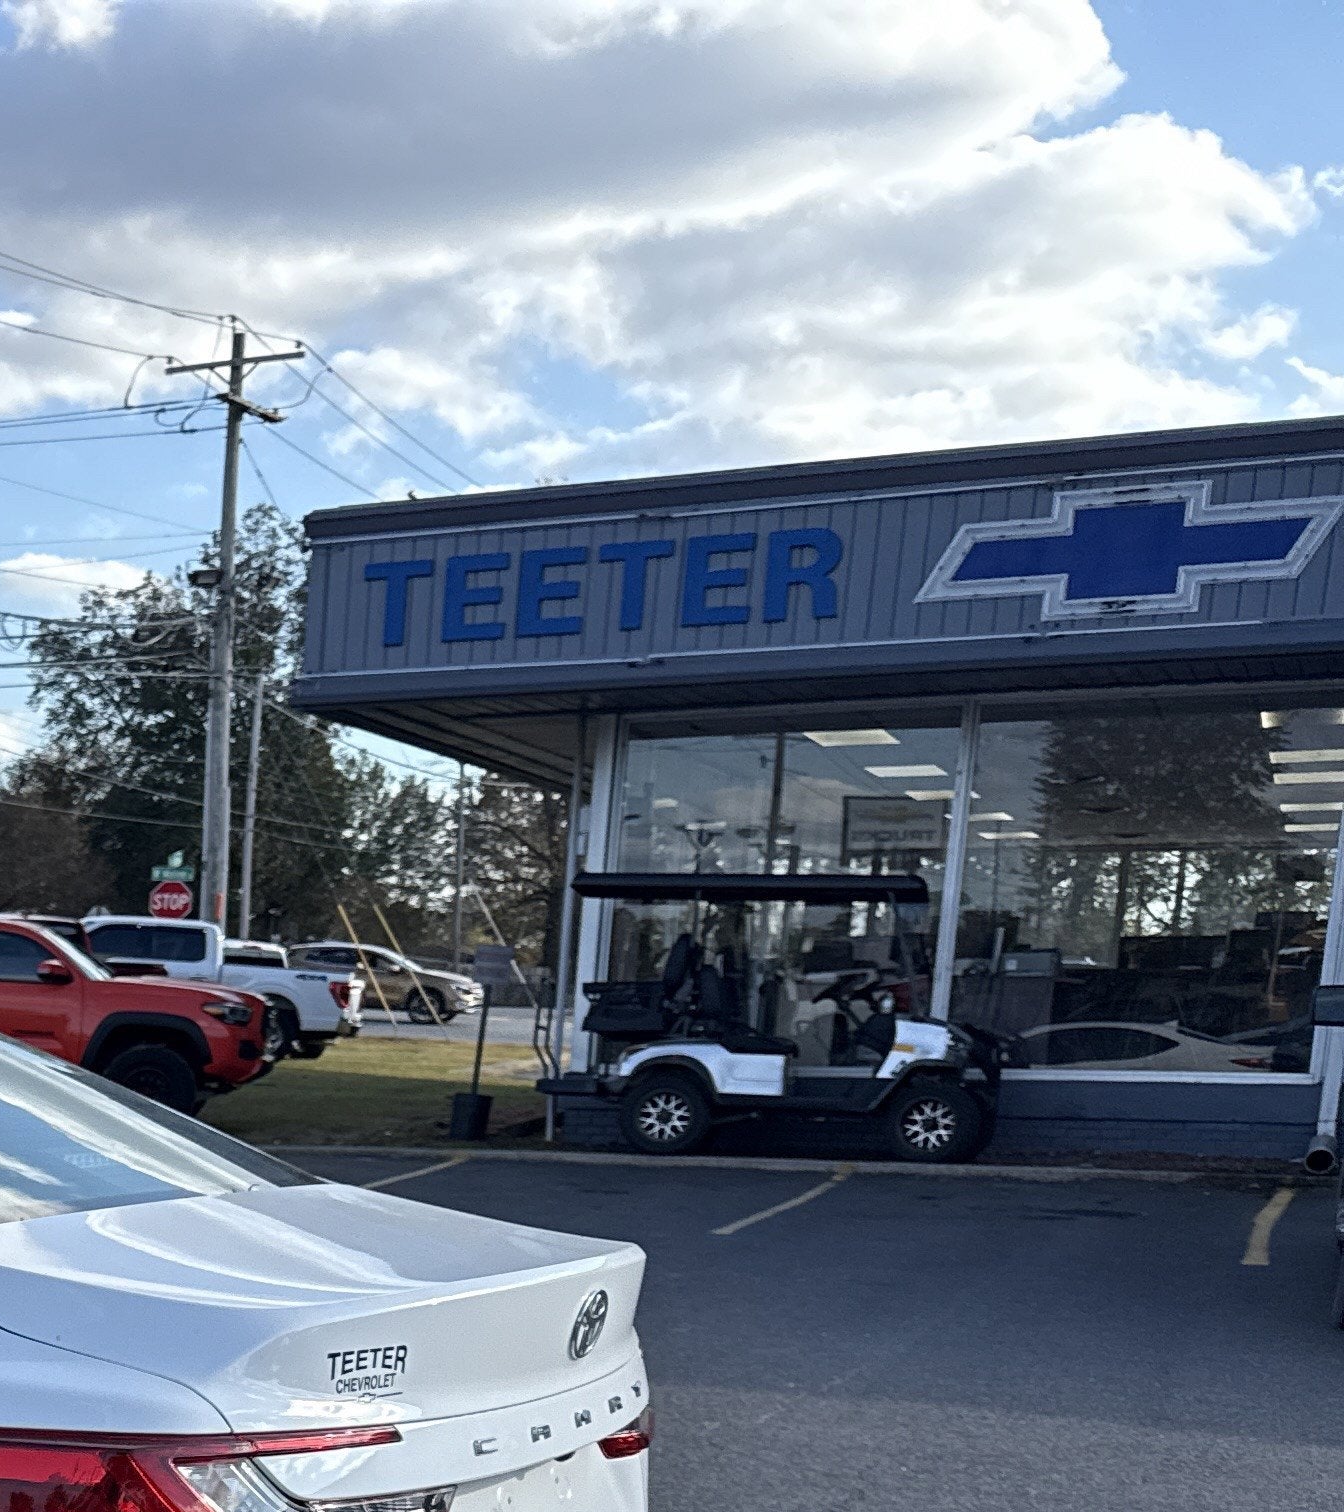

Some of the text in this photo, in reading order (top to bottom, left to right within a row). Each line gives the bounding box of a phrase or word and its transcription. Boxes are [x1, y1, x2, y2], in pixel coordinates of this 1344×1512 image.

[363, 527, 843, 648] TEETER
[152, 892, 190, 911] STOP
[327, 1345, 407, 1380] TEETER
[335, 1373, 396, 1394] CHEVROLET
